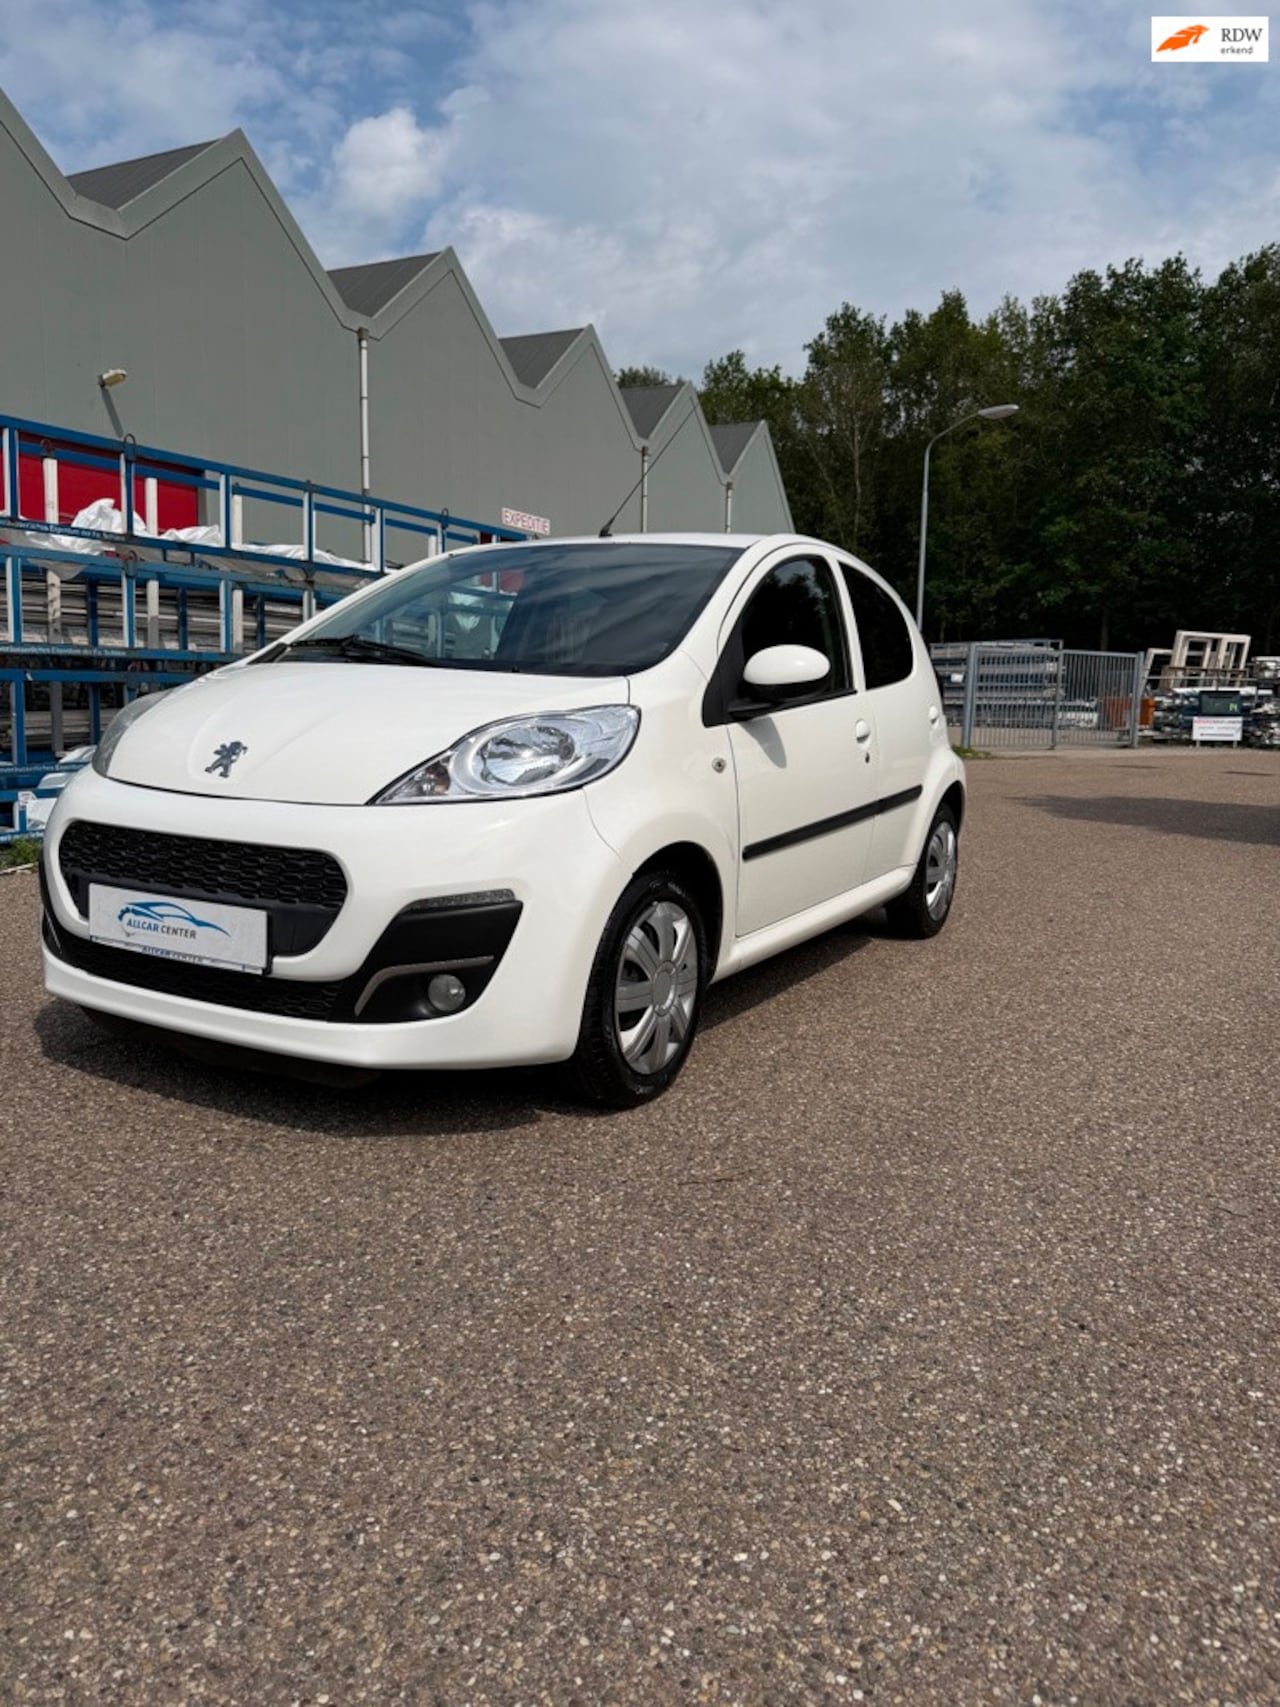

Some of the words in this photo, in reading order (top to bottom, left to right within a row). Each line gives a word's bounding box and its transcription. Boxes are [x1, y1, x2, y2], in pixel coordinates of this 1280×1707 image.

[503, 509, 549, 533] EXPEDITIE
[126, 917, 159, 932] ALLCAR
[160, 925, 197, 939] CENTER
